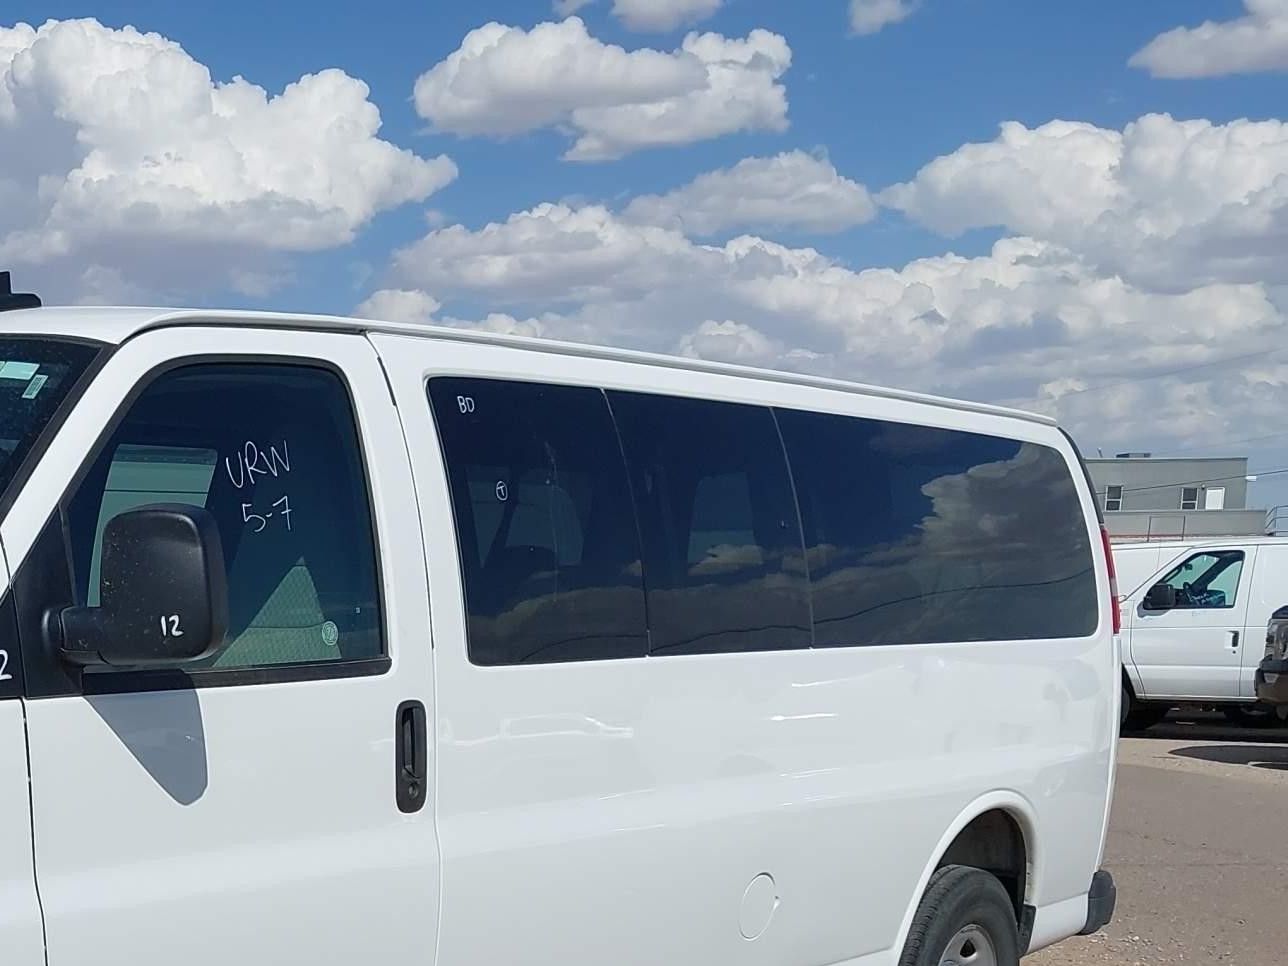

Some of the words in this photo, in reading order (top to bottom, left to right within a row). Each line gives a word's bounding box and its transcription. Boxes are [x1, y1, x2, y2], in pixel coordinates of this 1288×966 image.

[457, 395, 475, 414] BD
[241, 495, 292, 533] 5-7
[160, 614, 185, 637] 12
